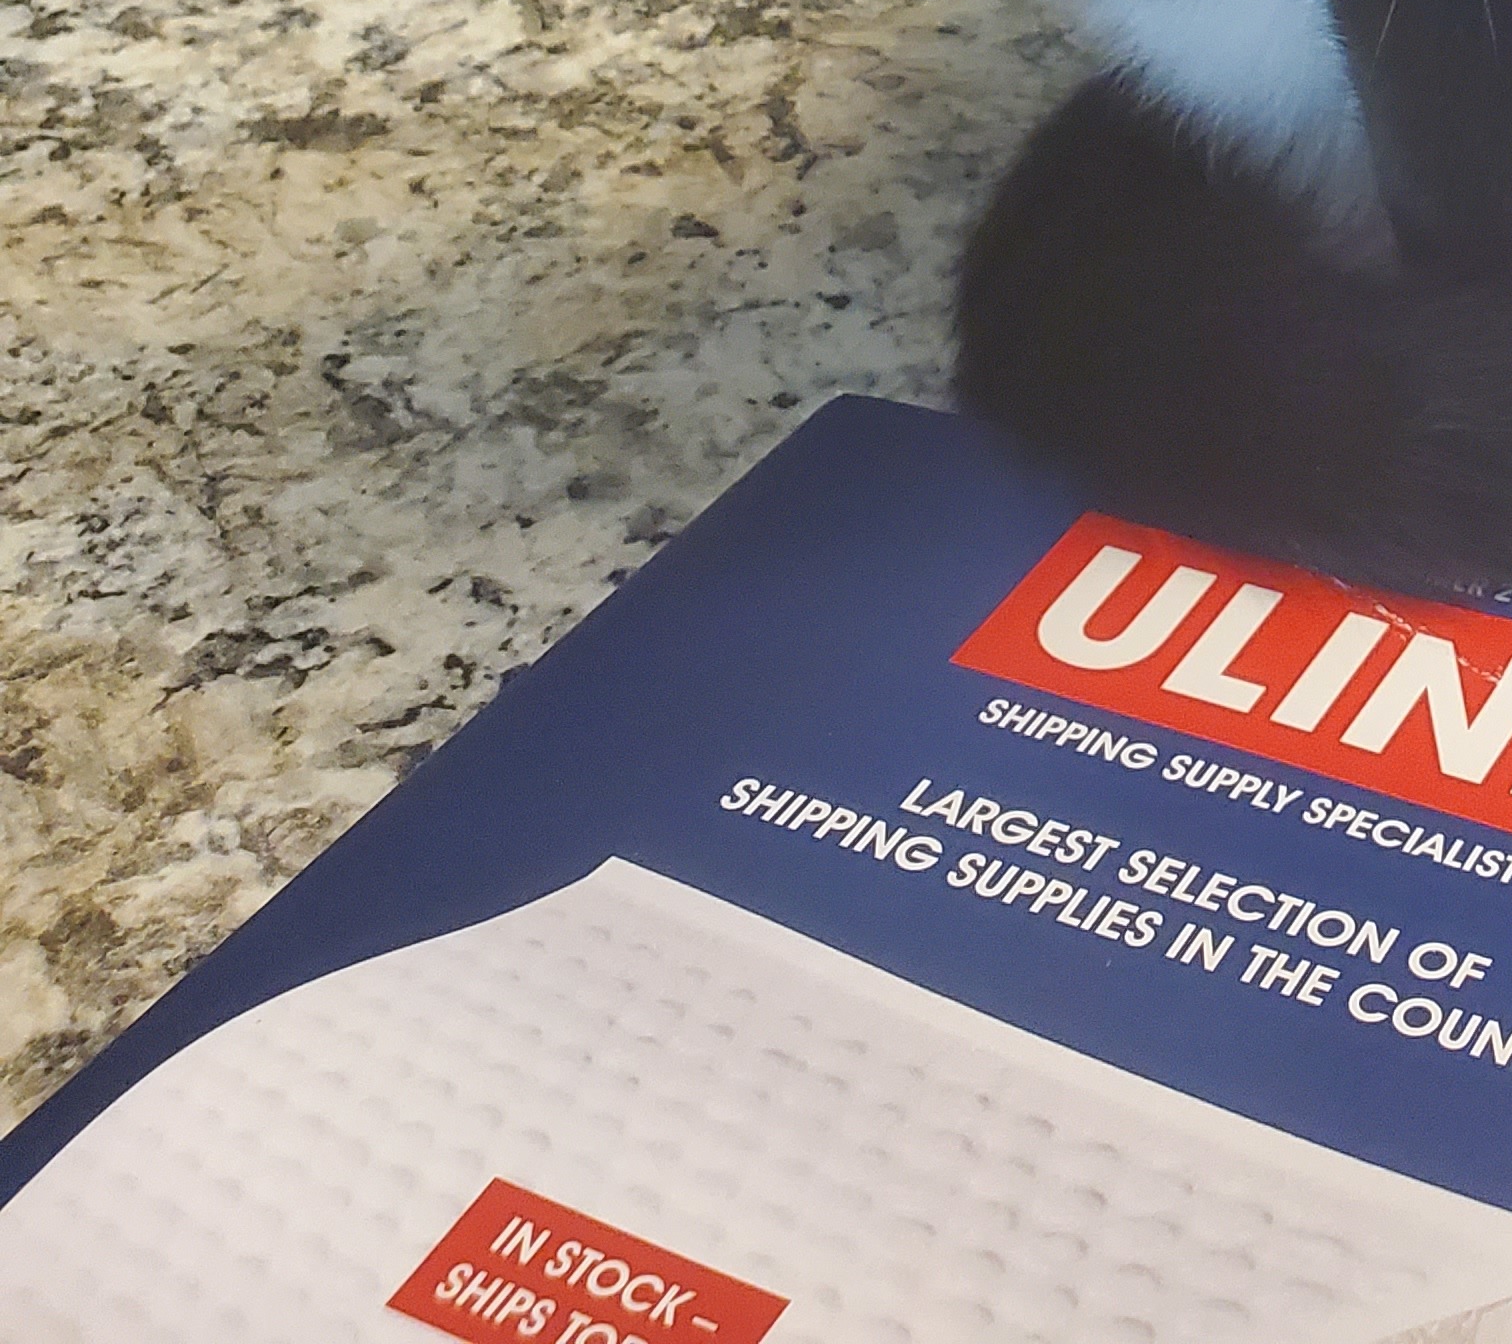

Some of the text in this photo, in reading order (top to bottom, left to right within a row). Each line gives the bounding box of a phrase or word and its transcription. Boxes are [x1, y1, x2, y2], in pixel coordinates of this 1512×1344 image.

[978, 699, 1159, 770] SHIPPING
[1162, 754, 1303, 814] SUPPLY
[719, 778, 943, 871] SHIPPING
[946, 852, 1164, 947] SUPPLIES
[1165, 922, 1235, 972] IN
[1240, 944, 1341, 1006] THE
[900, 778, 1493, 989] LARGEST SELECTION OF
[435, 1263, 557, 1337] SHIPS
[489, 1216, 551, 1265] IN
[544, 1240, 697, 1327] STOCK
